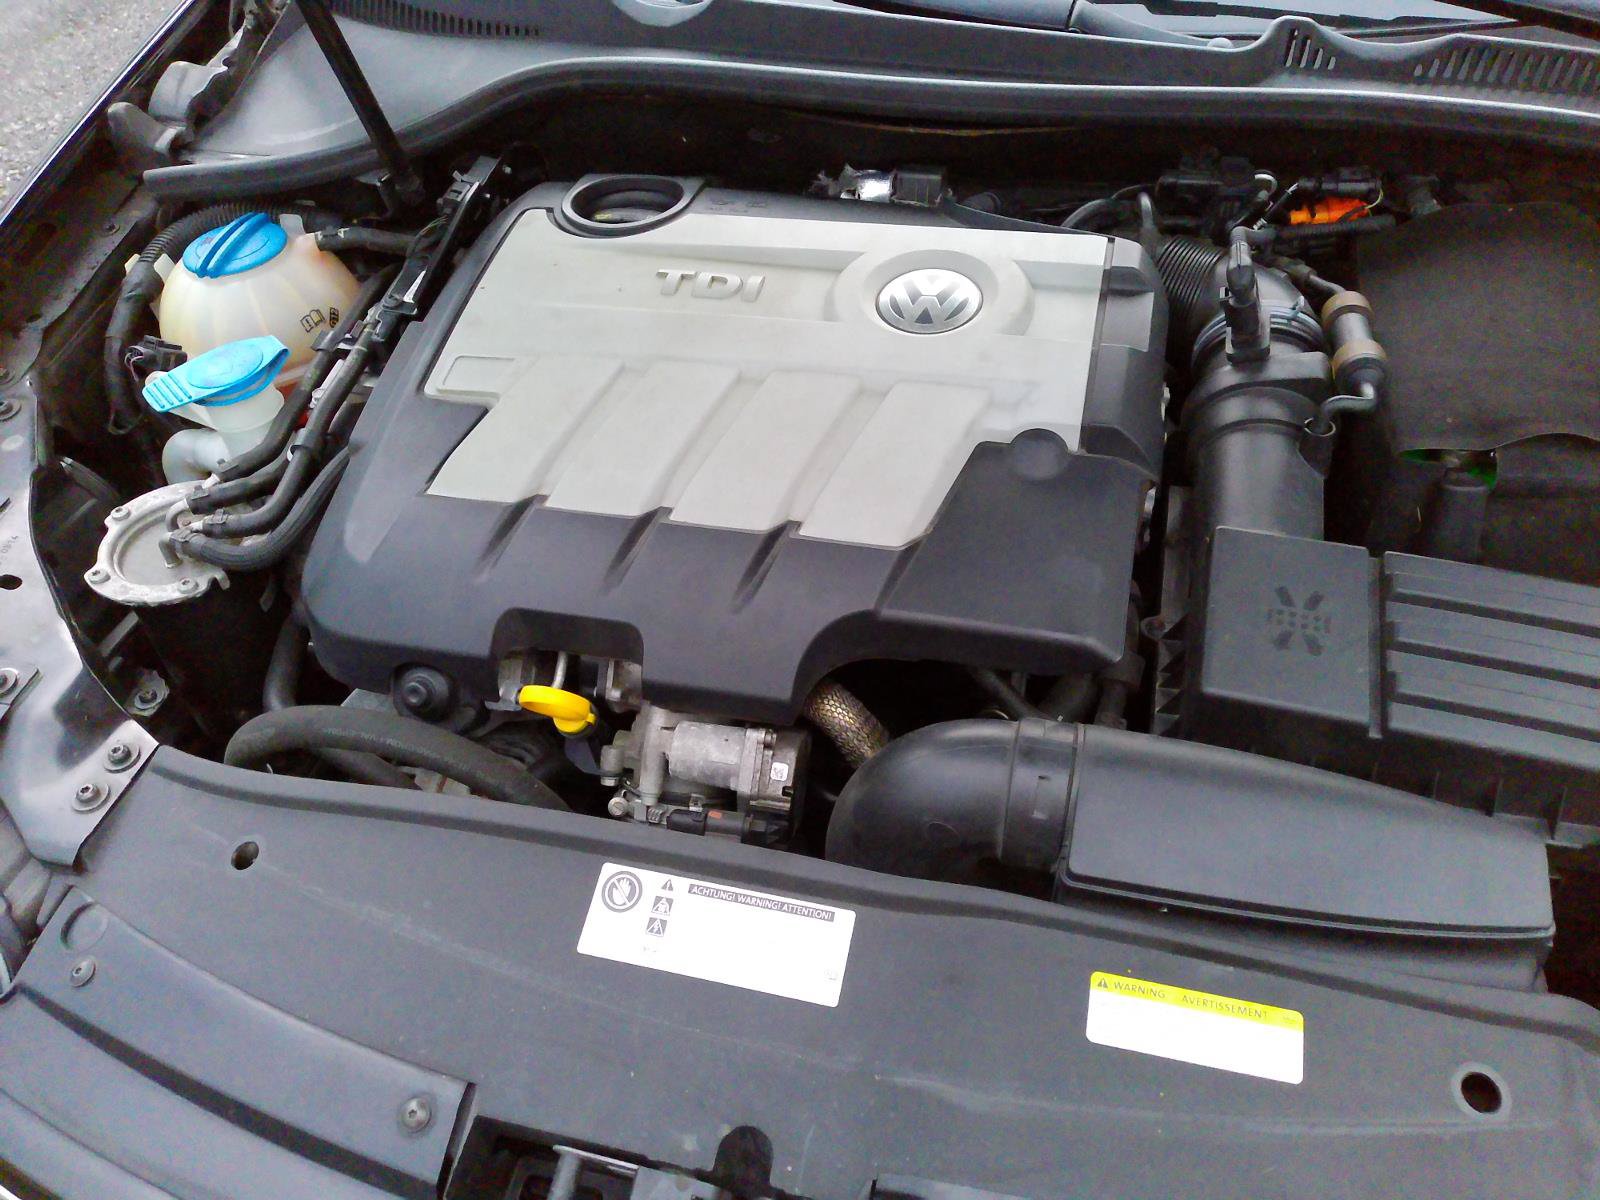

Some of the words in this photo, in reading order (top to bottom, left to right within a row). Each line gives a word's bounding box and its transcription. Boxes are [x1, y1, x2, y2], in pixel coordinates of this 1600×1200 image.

[656, 269, 765, 303] TDI
[691, 885, 736, 902] ACHTUNG!
[737, 895, 781, 911] WARNING!
[782, 903, 832, 920] ATTENTION!
[1113, 980, 1166, 999] WARNING
[1181, 994, 1268, 1018] AVERTISSEMENT
